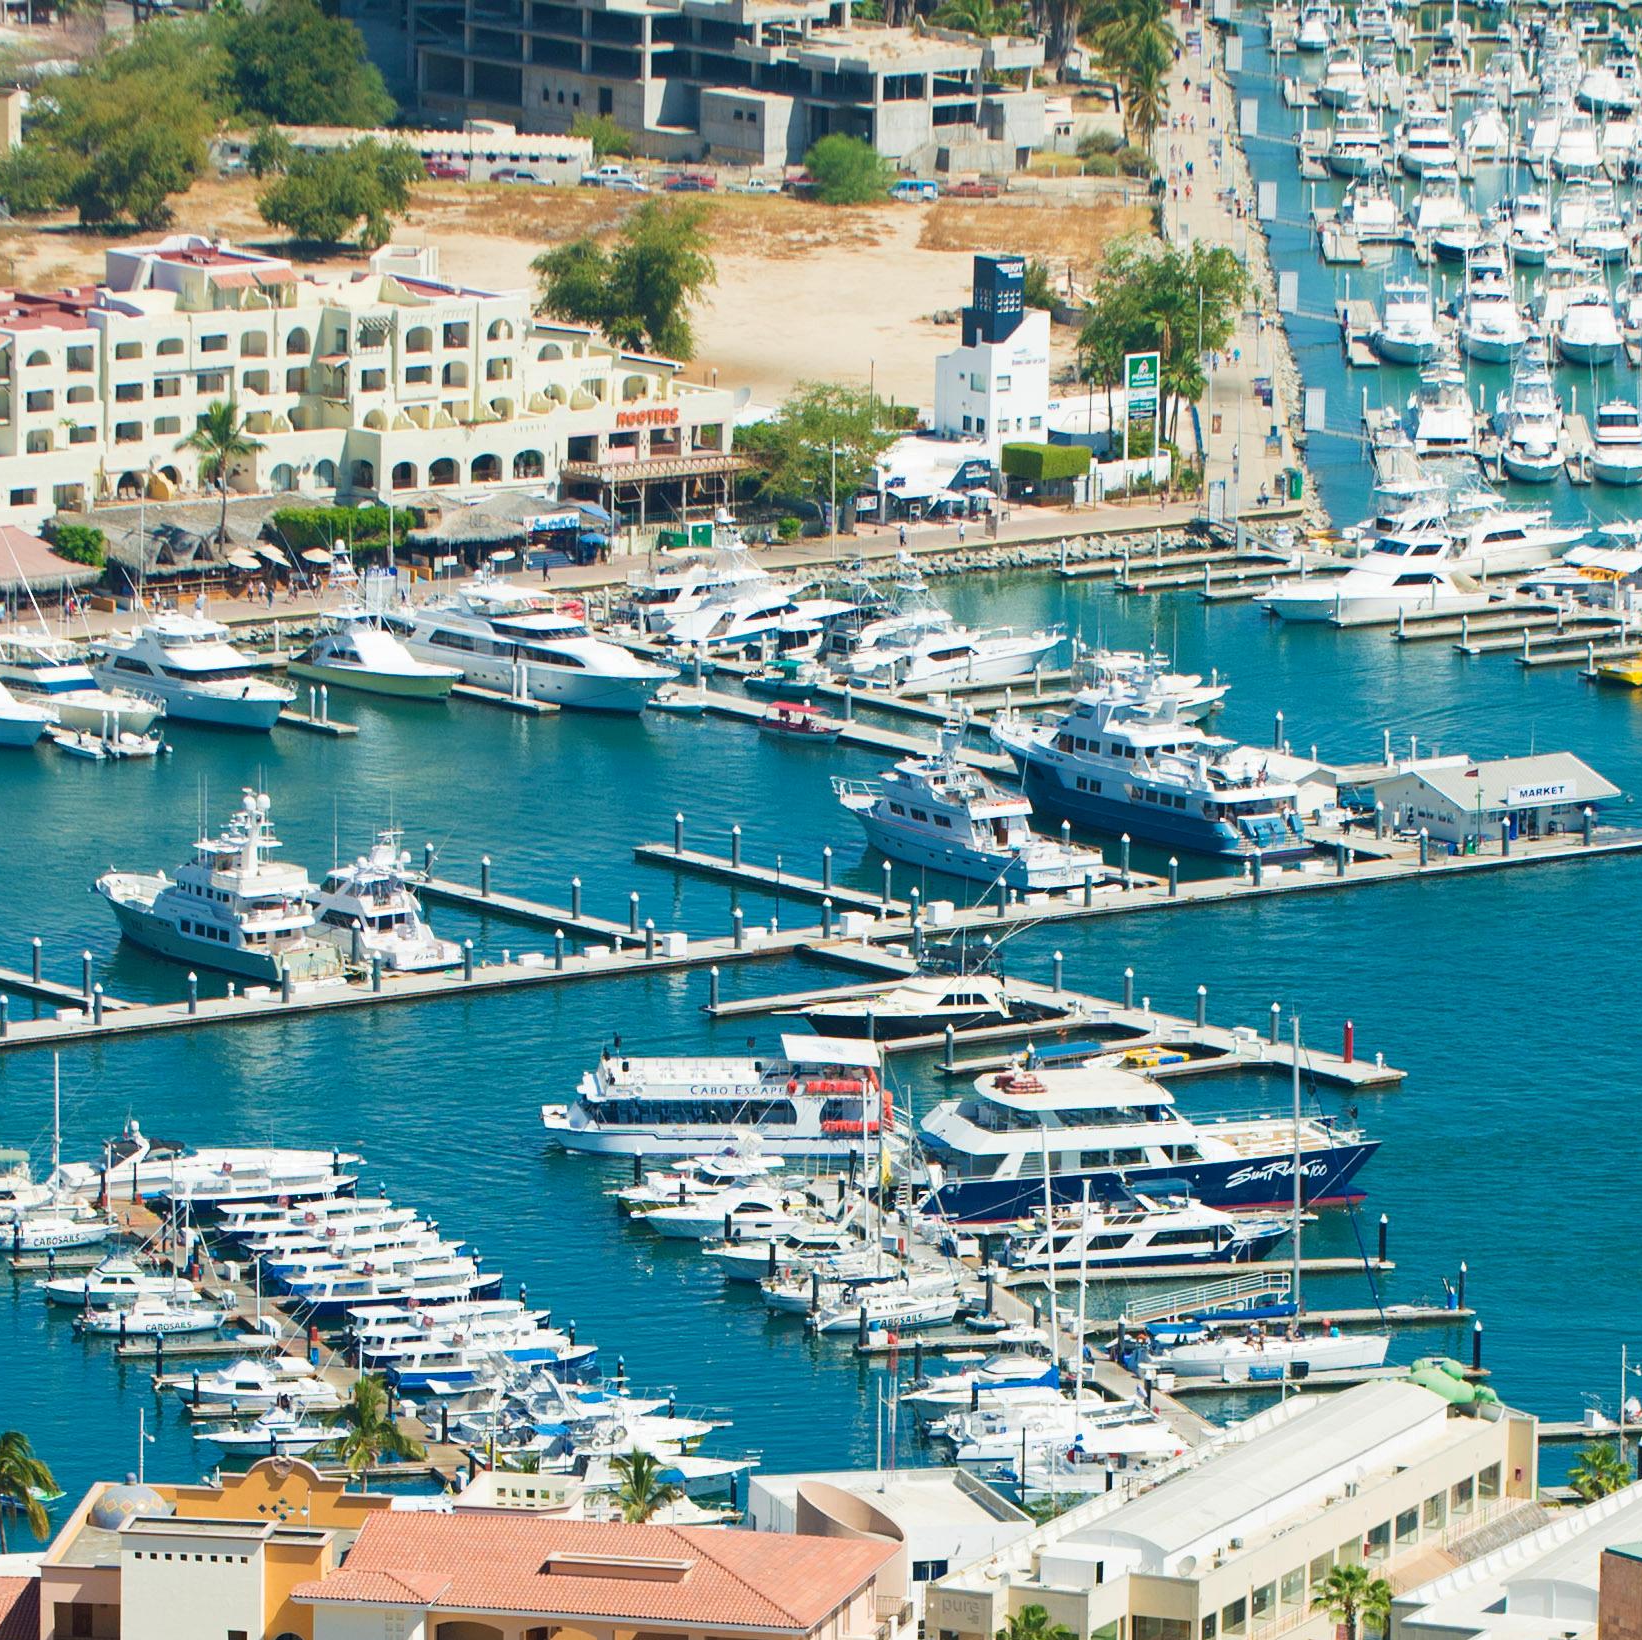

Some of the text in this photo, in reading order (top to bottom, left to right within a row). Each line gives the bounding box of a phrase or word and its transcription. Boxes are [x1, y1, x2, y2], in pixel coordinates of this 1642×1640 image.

[616, 408, 679, 428] HOOTERS
[1519, 785, 1565, 798] MARKET
[690, 1085, 728, 1095] CABO
[1309, 1164, 1328, 1178] 100
[33, 1233, 80, 1247] CABOSAILS
[145, 1321, 192, 1331] CABOSAILS
[942, 1598, 980, 1615] pure
